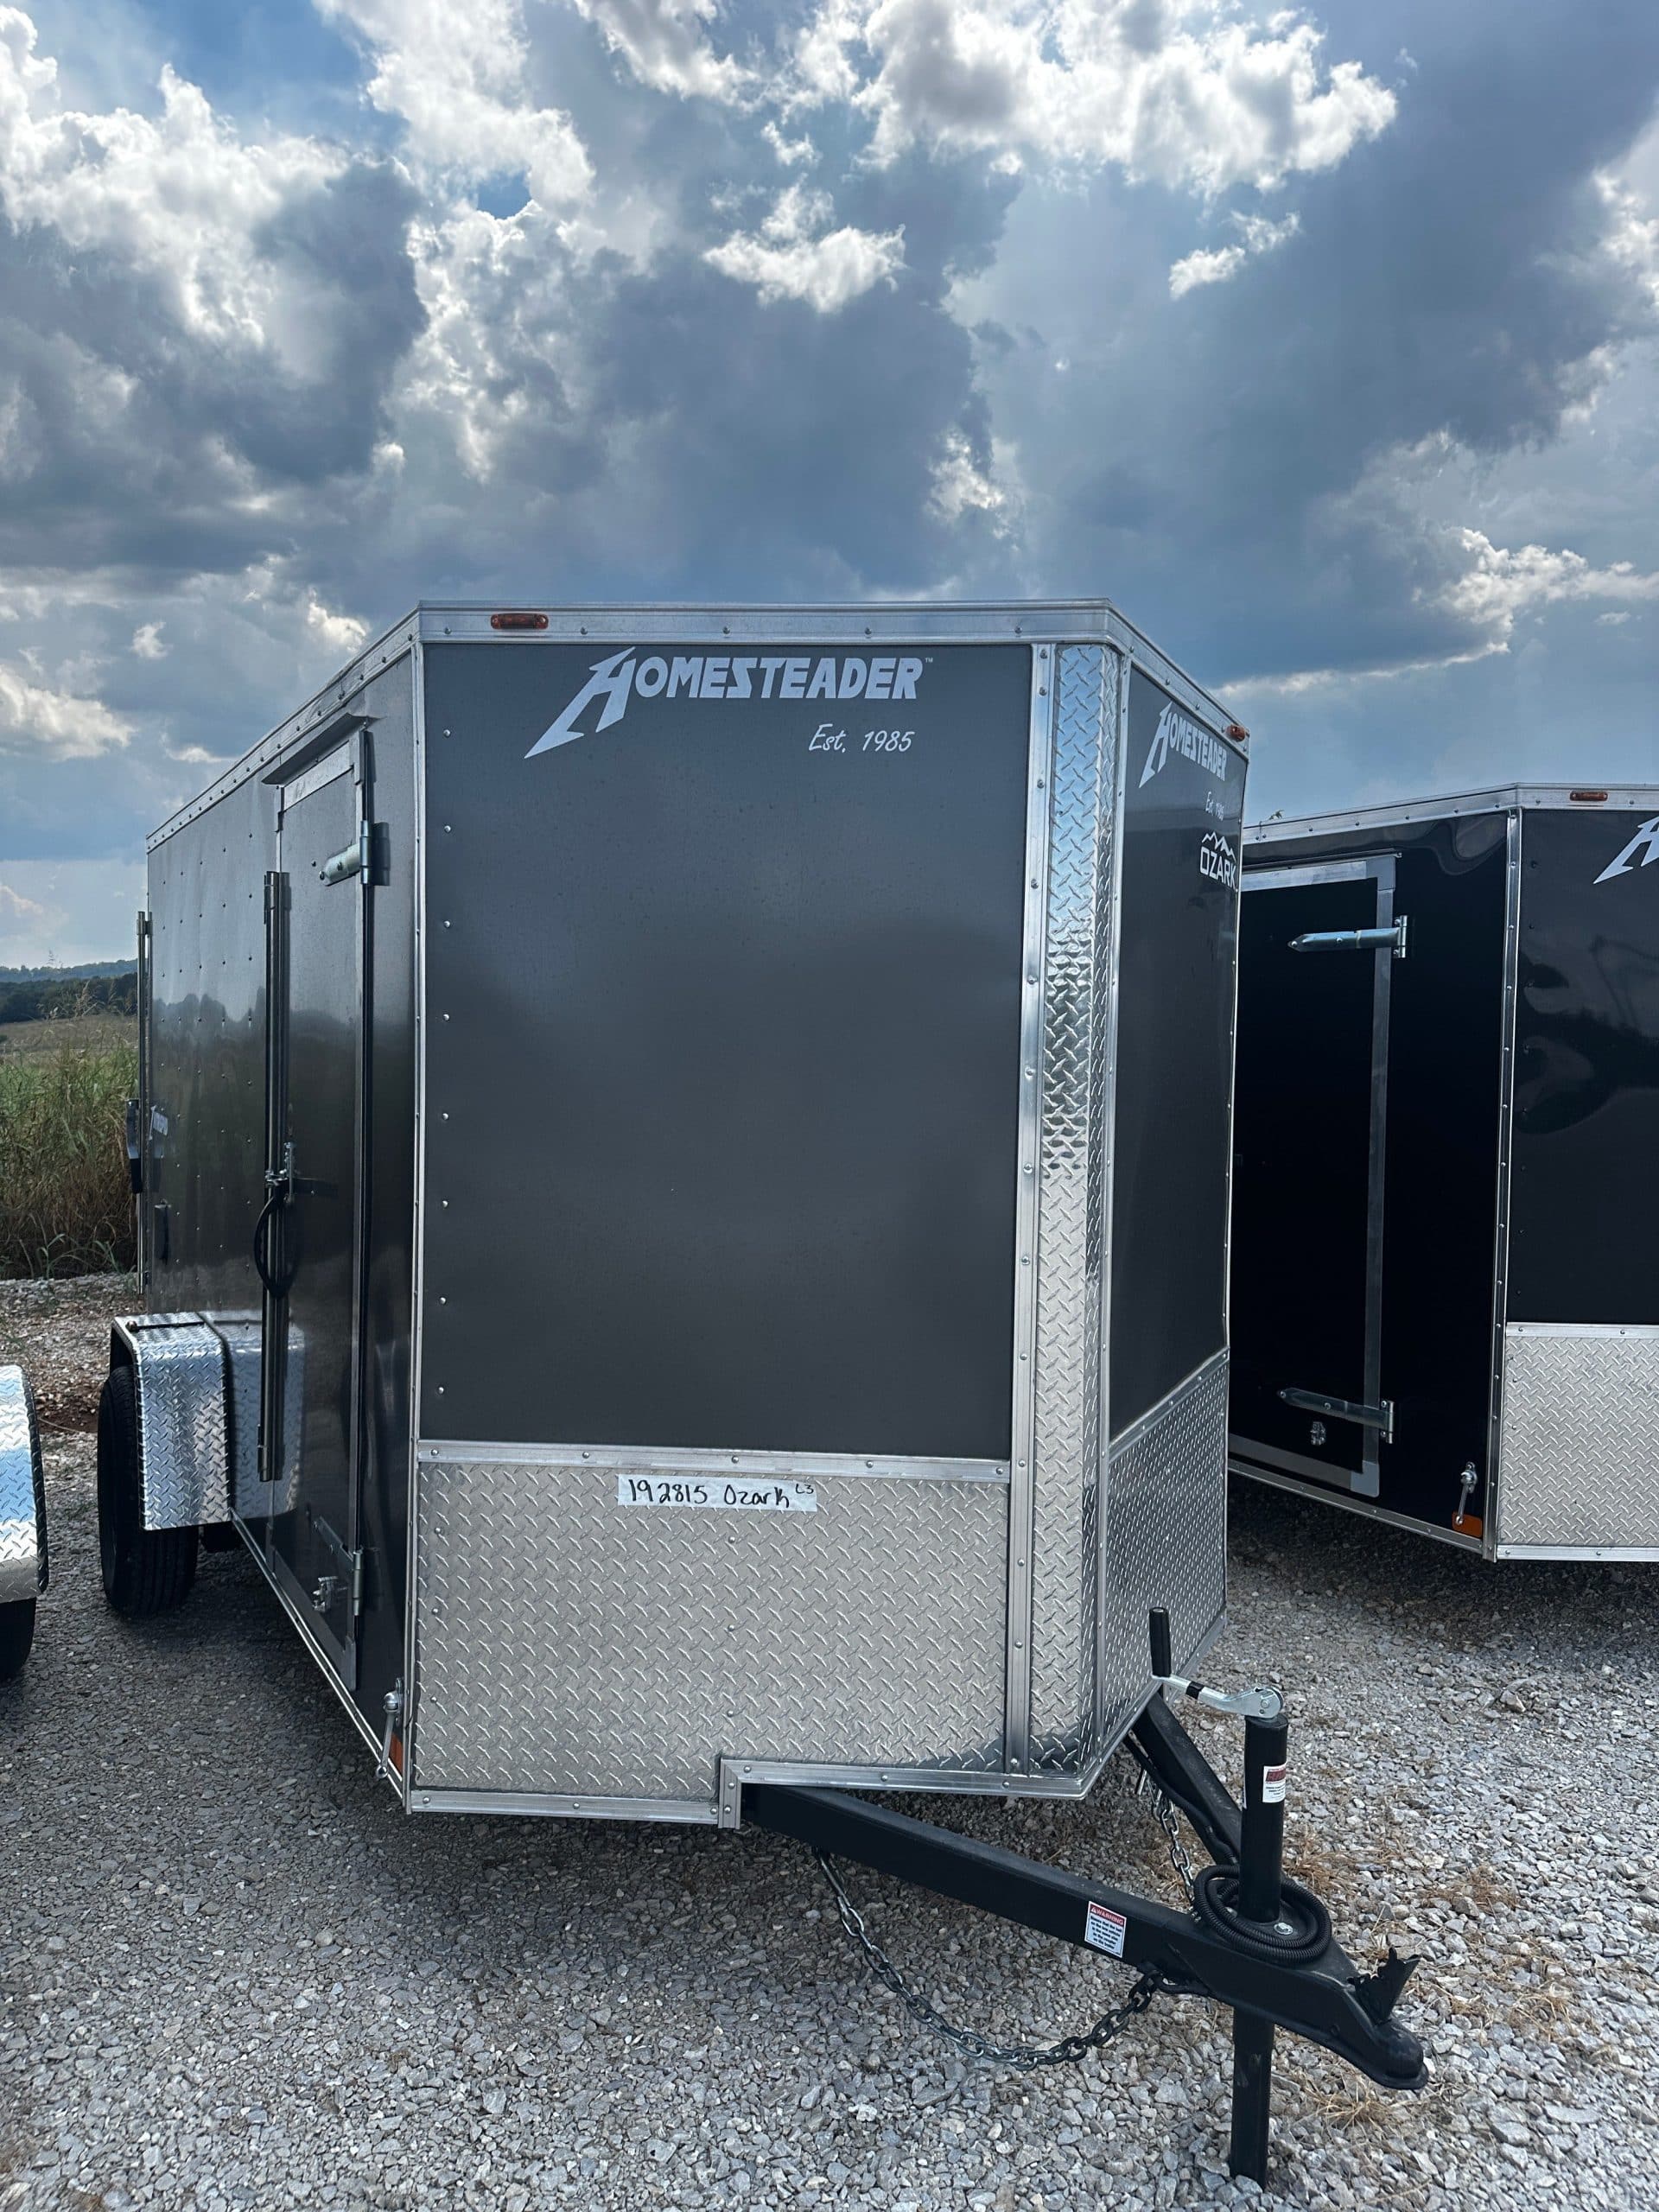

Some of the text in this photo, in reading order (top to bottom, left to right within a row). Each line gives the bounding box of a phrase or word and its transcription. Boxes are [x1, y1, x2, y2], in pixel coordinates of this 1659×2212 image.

[524, 646, 923, 759] HOMESTEADER
[808, 723, 916, 753] Est. 1985
[1139, 701, 1227, 788] HOMESTEADER
[1200, 846, 1236, 889] OZARK
[628, 1478, 708, 1504] 192815
[724, 1484, 790, 1509] Ozark
[1096, 1908, 1124, 1926] WARNING
